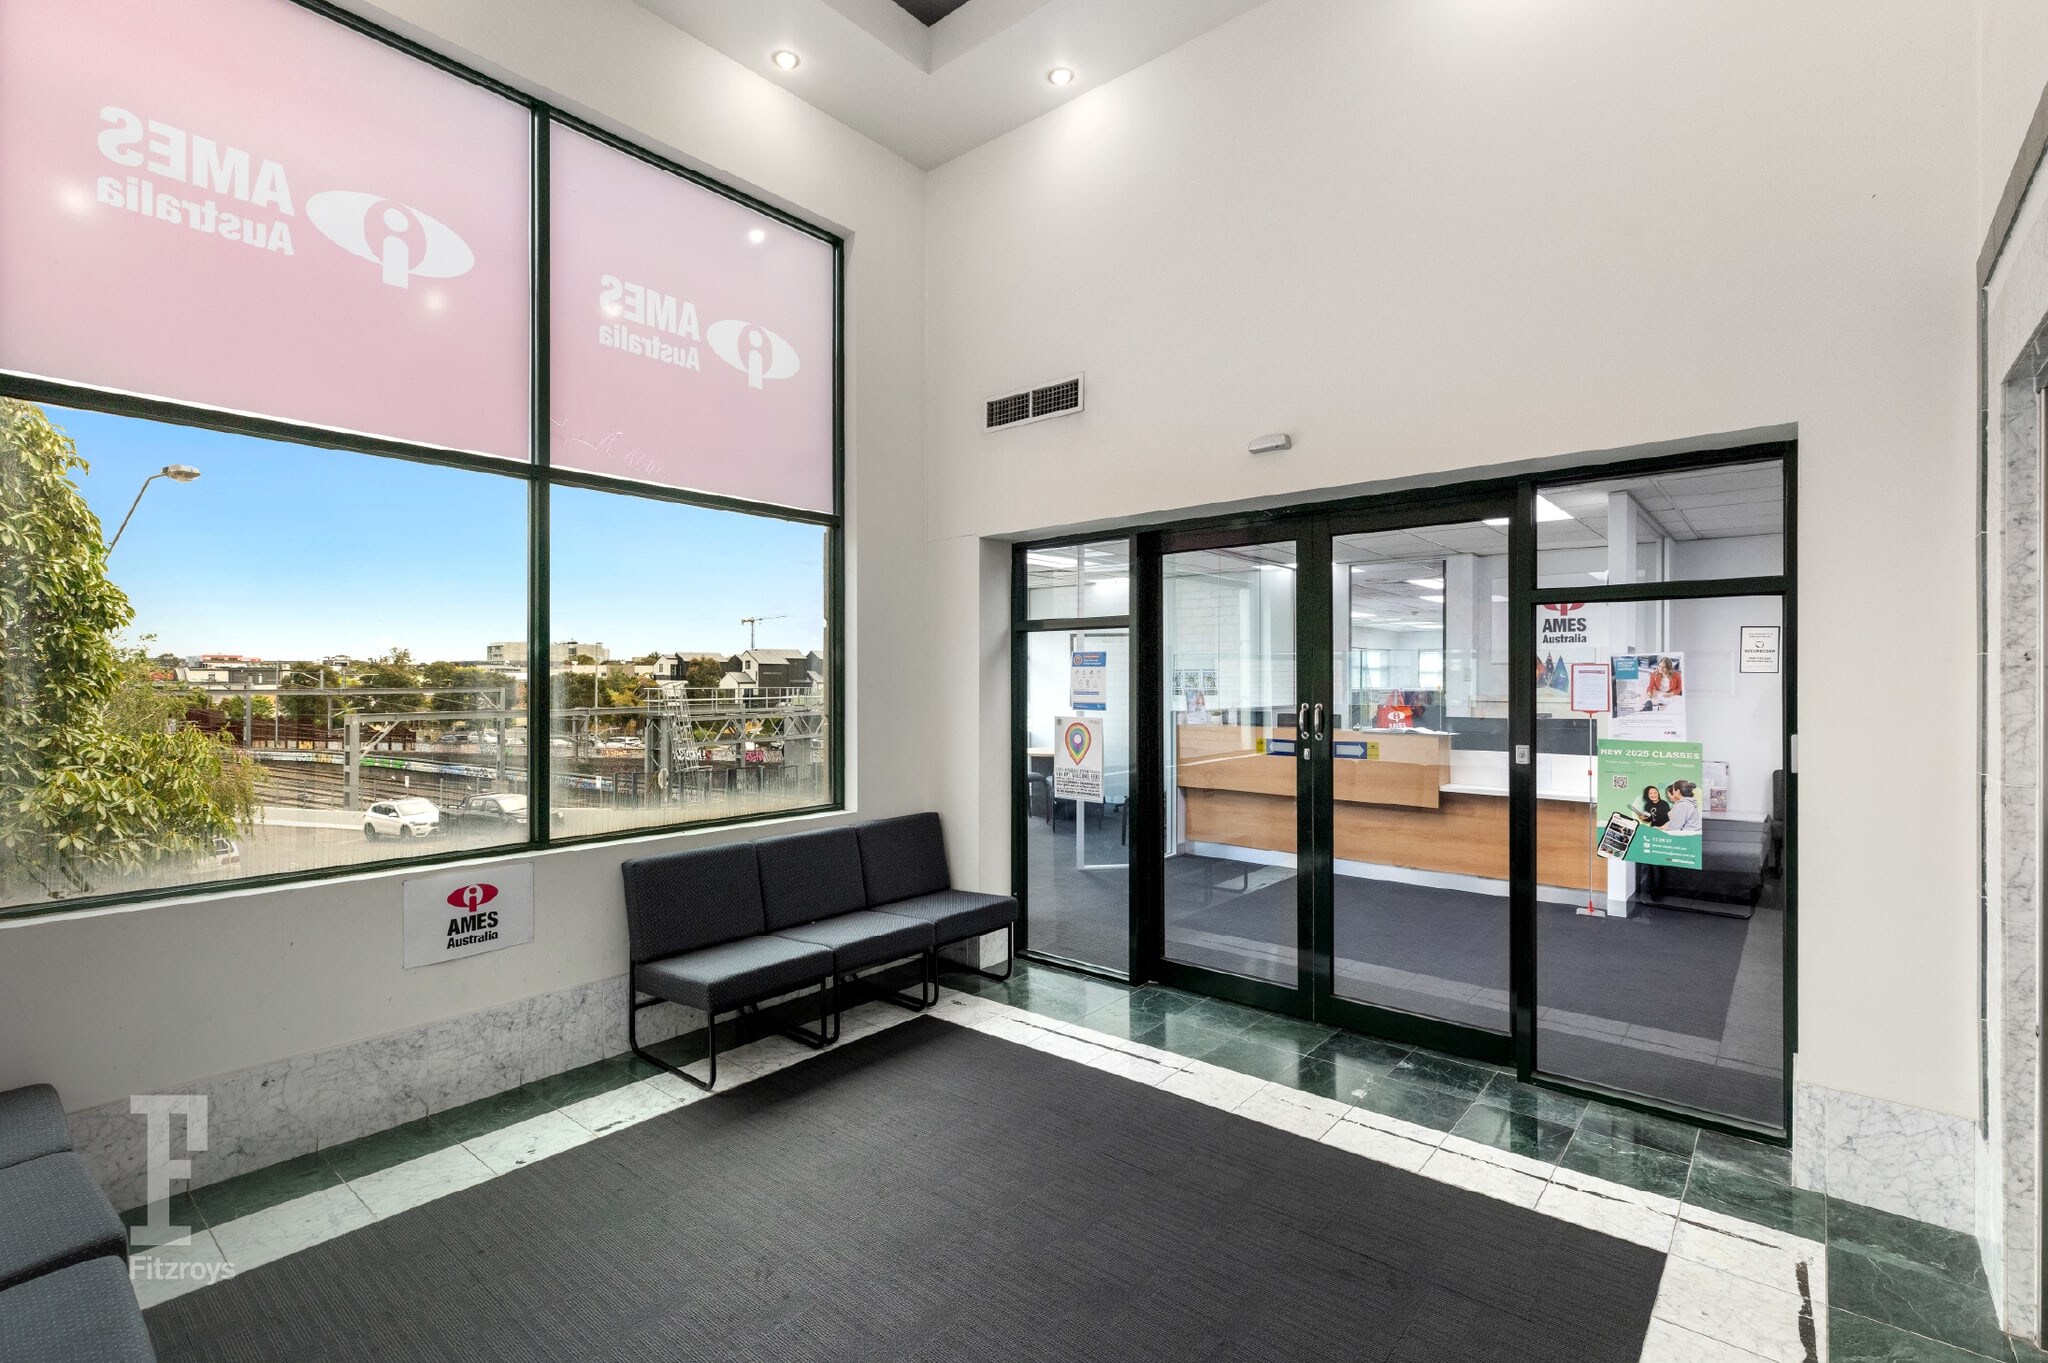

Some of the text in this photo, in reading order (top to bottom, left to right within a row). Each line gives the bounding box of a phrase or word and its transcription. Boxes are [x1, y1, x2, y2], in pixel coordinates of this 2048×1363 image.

[1542, 617, 1587, 633] AMES
[1542, 633, 1587, 644] Australia
[1600, 748, 1701, 760] NEW 2025 CLASSES
[446, 911, 499, 937] AMES
[446, 930, 499, 950] Australia
